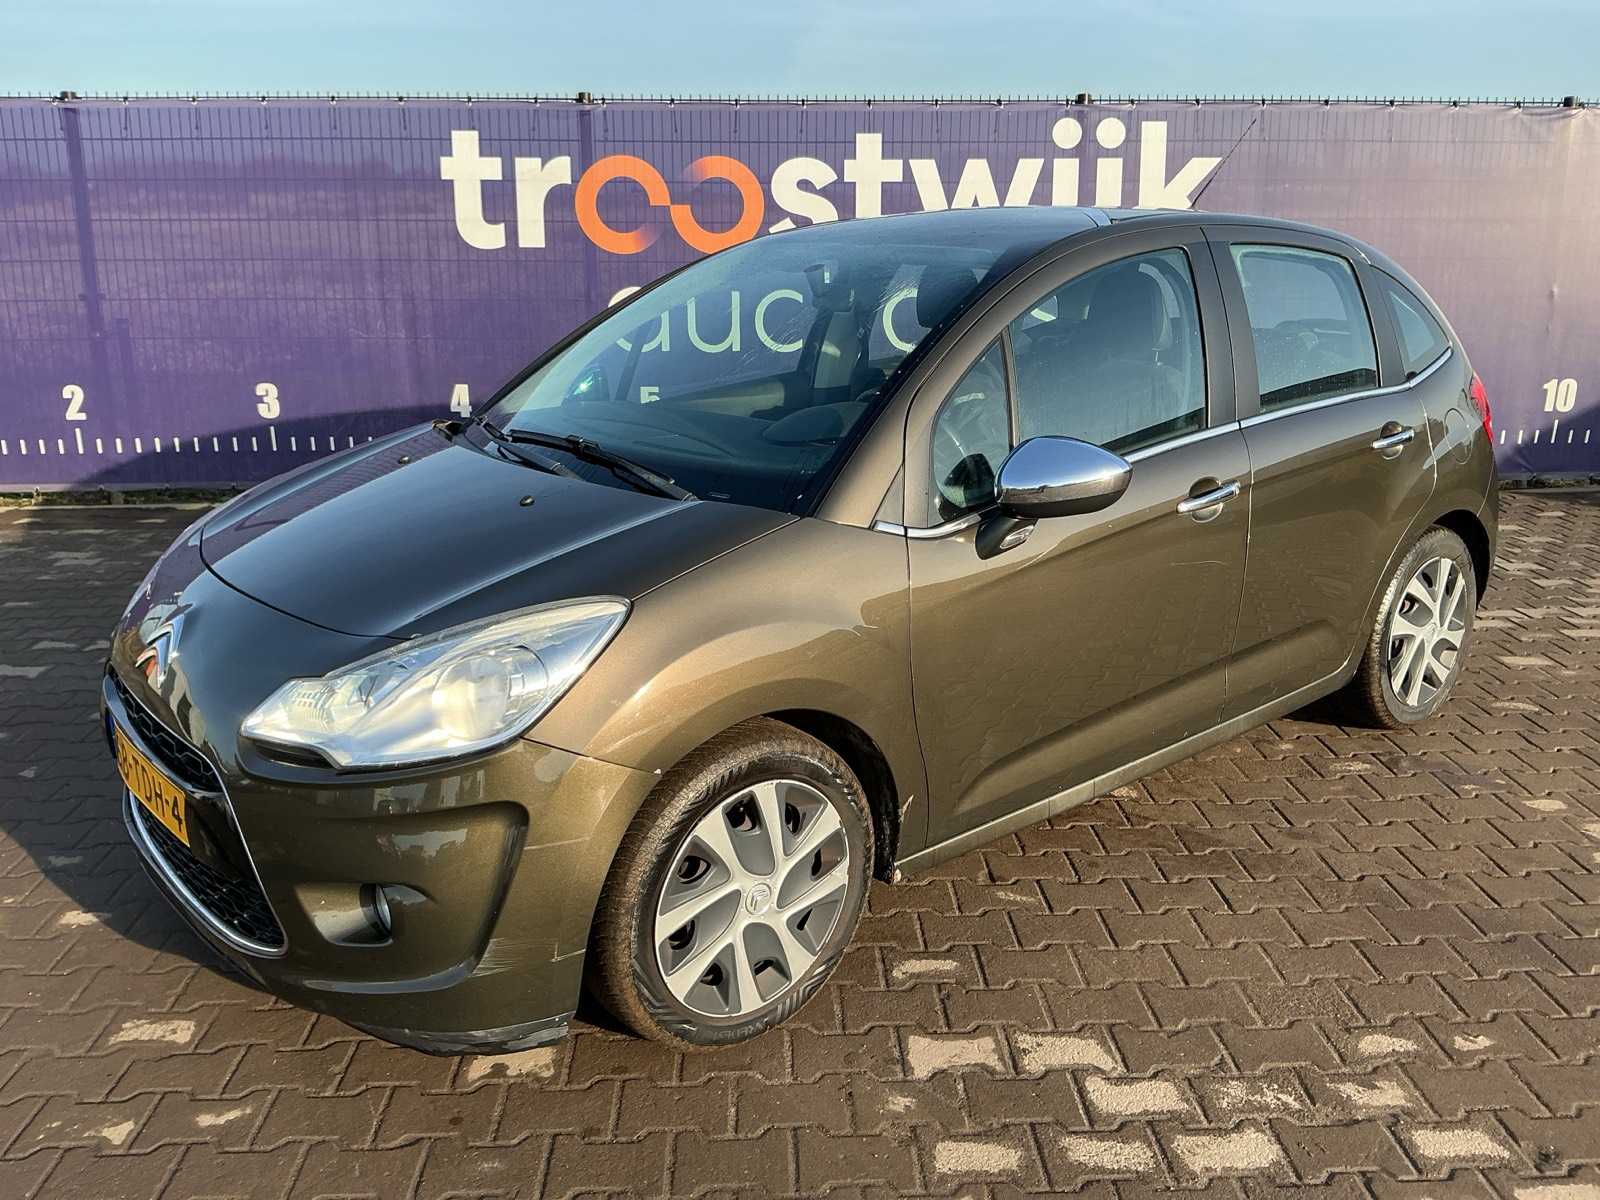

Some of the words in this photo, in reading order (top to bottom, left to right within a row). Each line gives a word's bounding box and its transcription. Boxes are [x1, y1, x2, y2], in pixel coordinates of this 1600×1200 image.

[440, 117, 1222, 255] troostwijk
[62, 384, 87, 421] 2
[255, 383, 281, 419] 3
[450, 383, 473, 418] 4
[1543, 378, 1578, 412] 10
